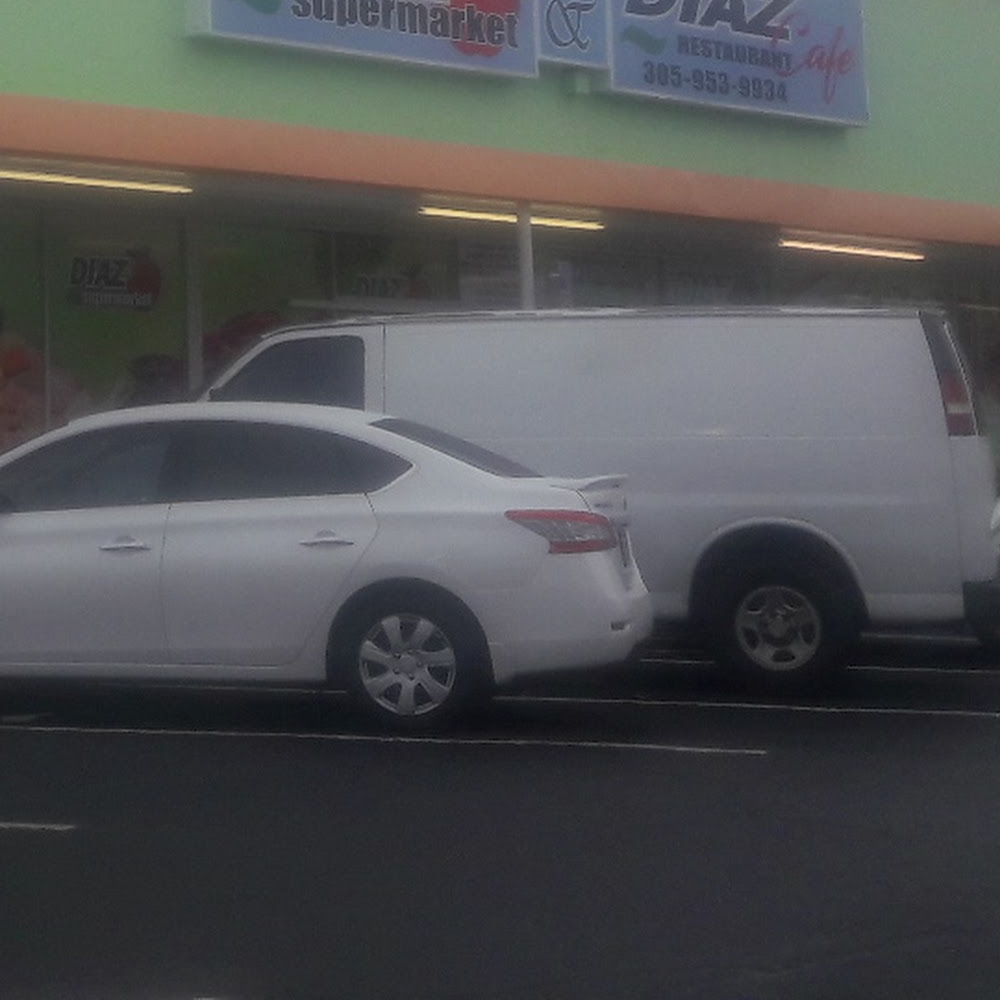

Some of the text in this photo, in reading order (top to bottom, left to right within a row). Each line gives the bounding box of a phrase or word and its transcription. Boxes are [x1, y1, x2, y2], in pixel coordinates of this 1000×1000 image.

[677, 34, 793, 71] RESTAURANT
[642, 60, 788, 103] 305-953-9934
[70, 256, 130, 288] DIAZ
